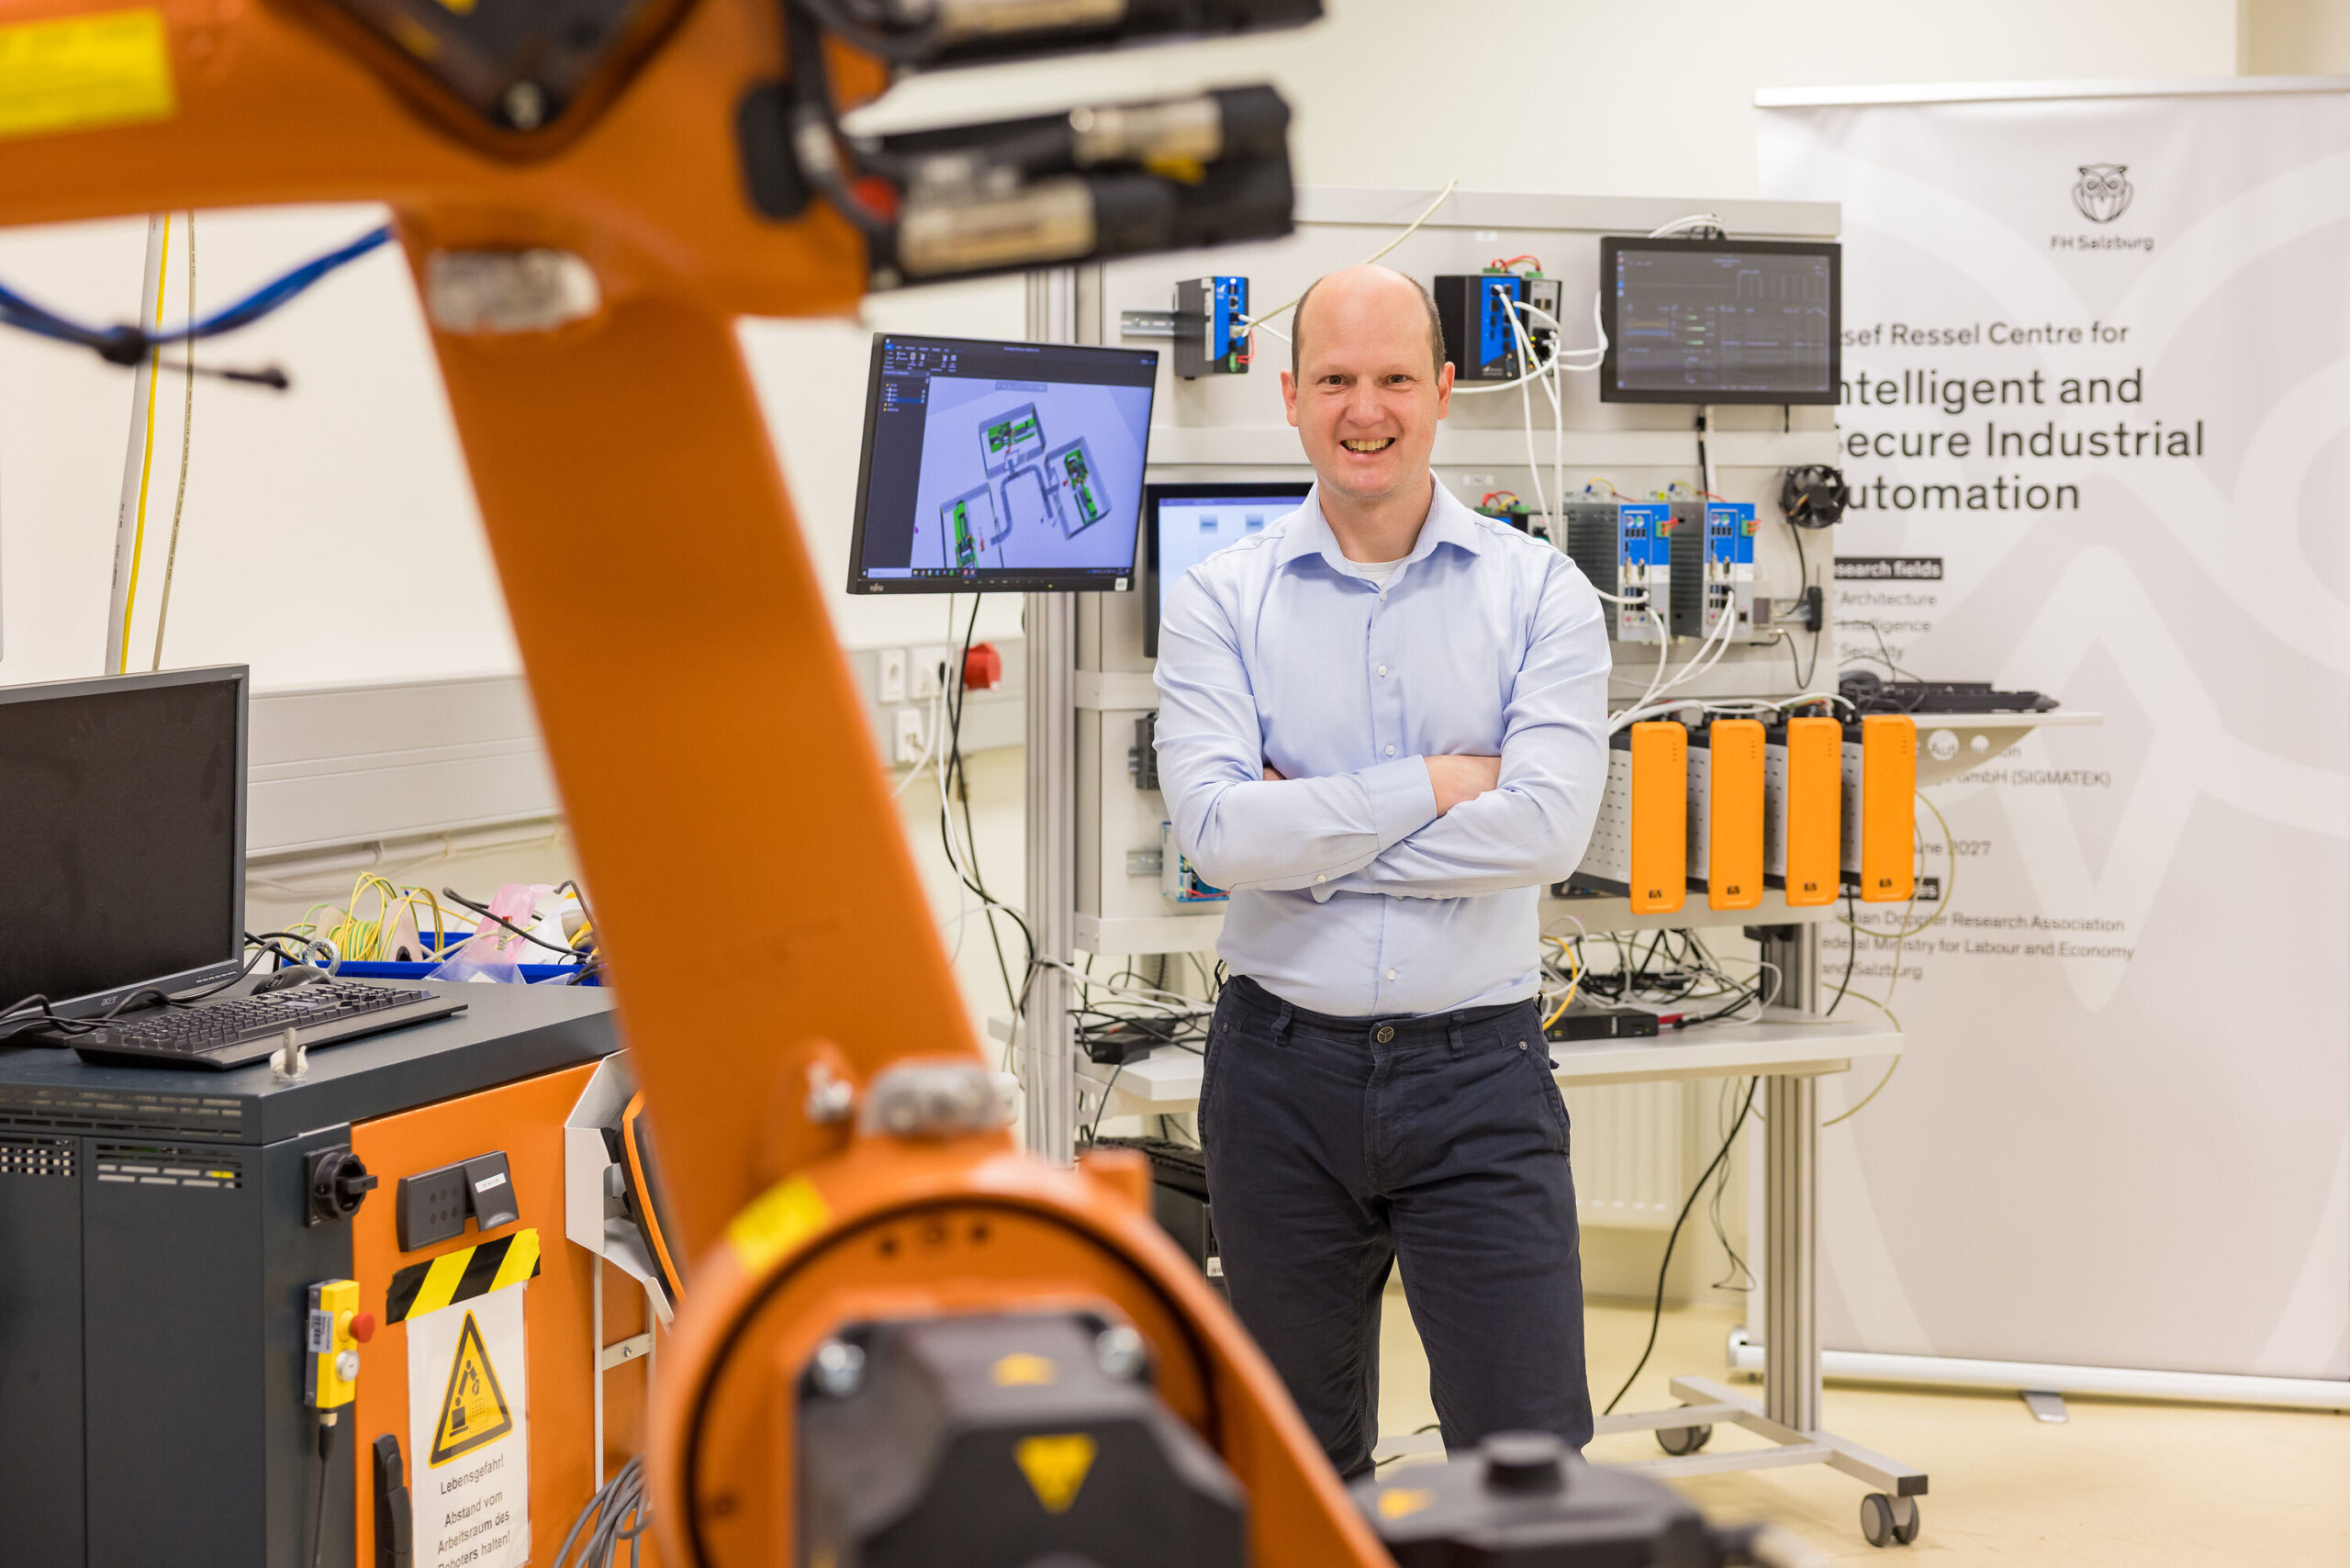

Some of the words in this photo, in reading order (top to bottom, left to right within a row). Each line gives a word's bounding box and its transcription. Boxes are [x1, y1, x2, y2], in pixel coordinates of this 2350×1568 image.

[2077, 234, 2154, 252] Salzburg
[1841, 323, 1883, 346] sef
[1891, 322, 1980, 346] Ressel
[1988, 321, 2083, 345] Centre
[2091, 320, 2130, 345] for
[1841, 369, 2045, 415] ntelligent
[2059, 367, 2143, 404] and
[1839, 425, 1971, 458] ecure
[1986, 420, 2204, 458] Industrial
[1847, 476, 2080, 511] utomation
[1893, 559, 1942, 578] fields
[1840, 591, 1937, 606] Architecture
[2012, 768, 2111, 789] (SIGMATEK)
[1953, 912, 2028, 929] Research
[2031, 915, 2125, 933] Association
[1940, 937, 1961, 953] for
[1964, 939, 2020, 956] Labour
[2025, 942, 2055, 957] and
[2059, 942, 2135, 962] Economy
[441, 1454, 504, 1495] Lebensgefahr!
[444, 1498, 482, 1528] Abstand
[484, 1491, 503, 1508] vom
[438, 1519, 493, 1554] Arbeitsraum
[495, 1510, 510, 1526] des
[481, 1529, 510, 1556] halten!
